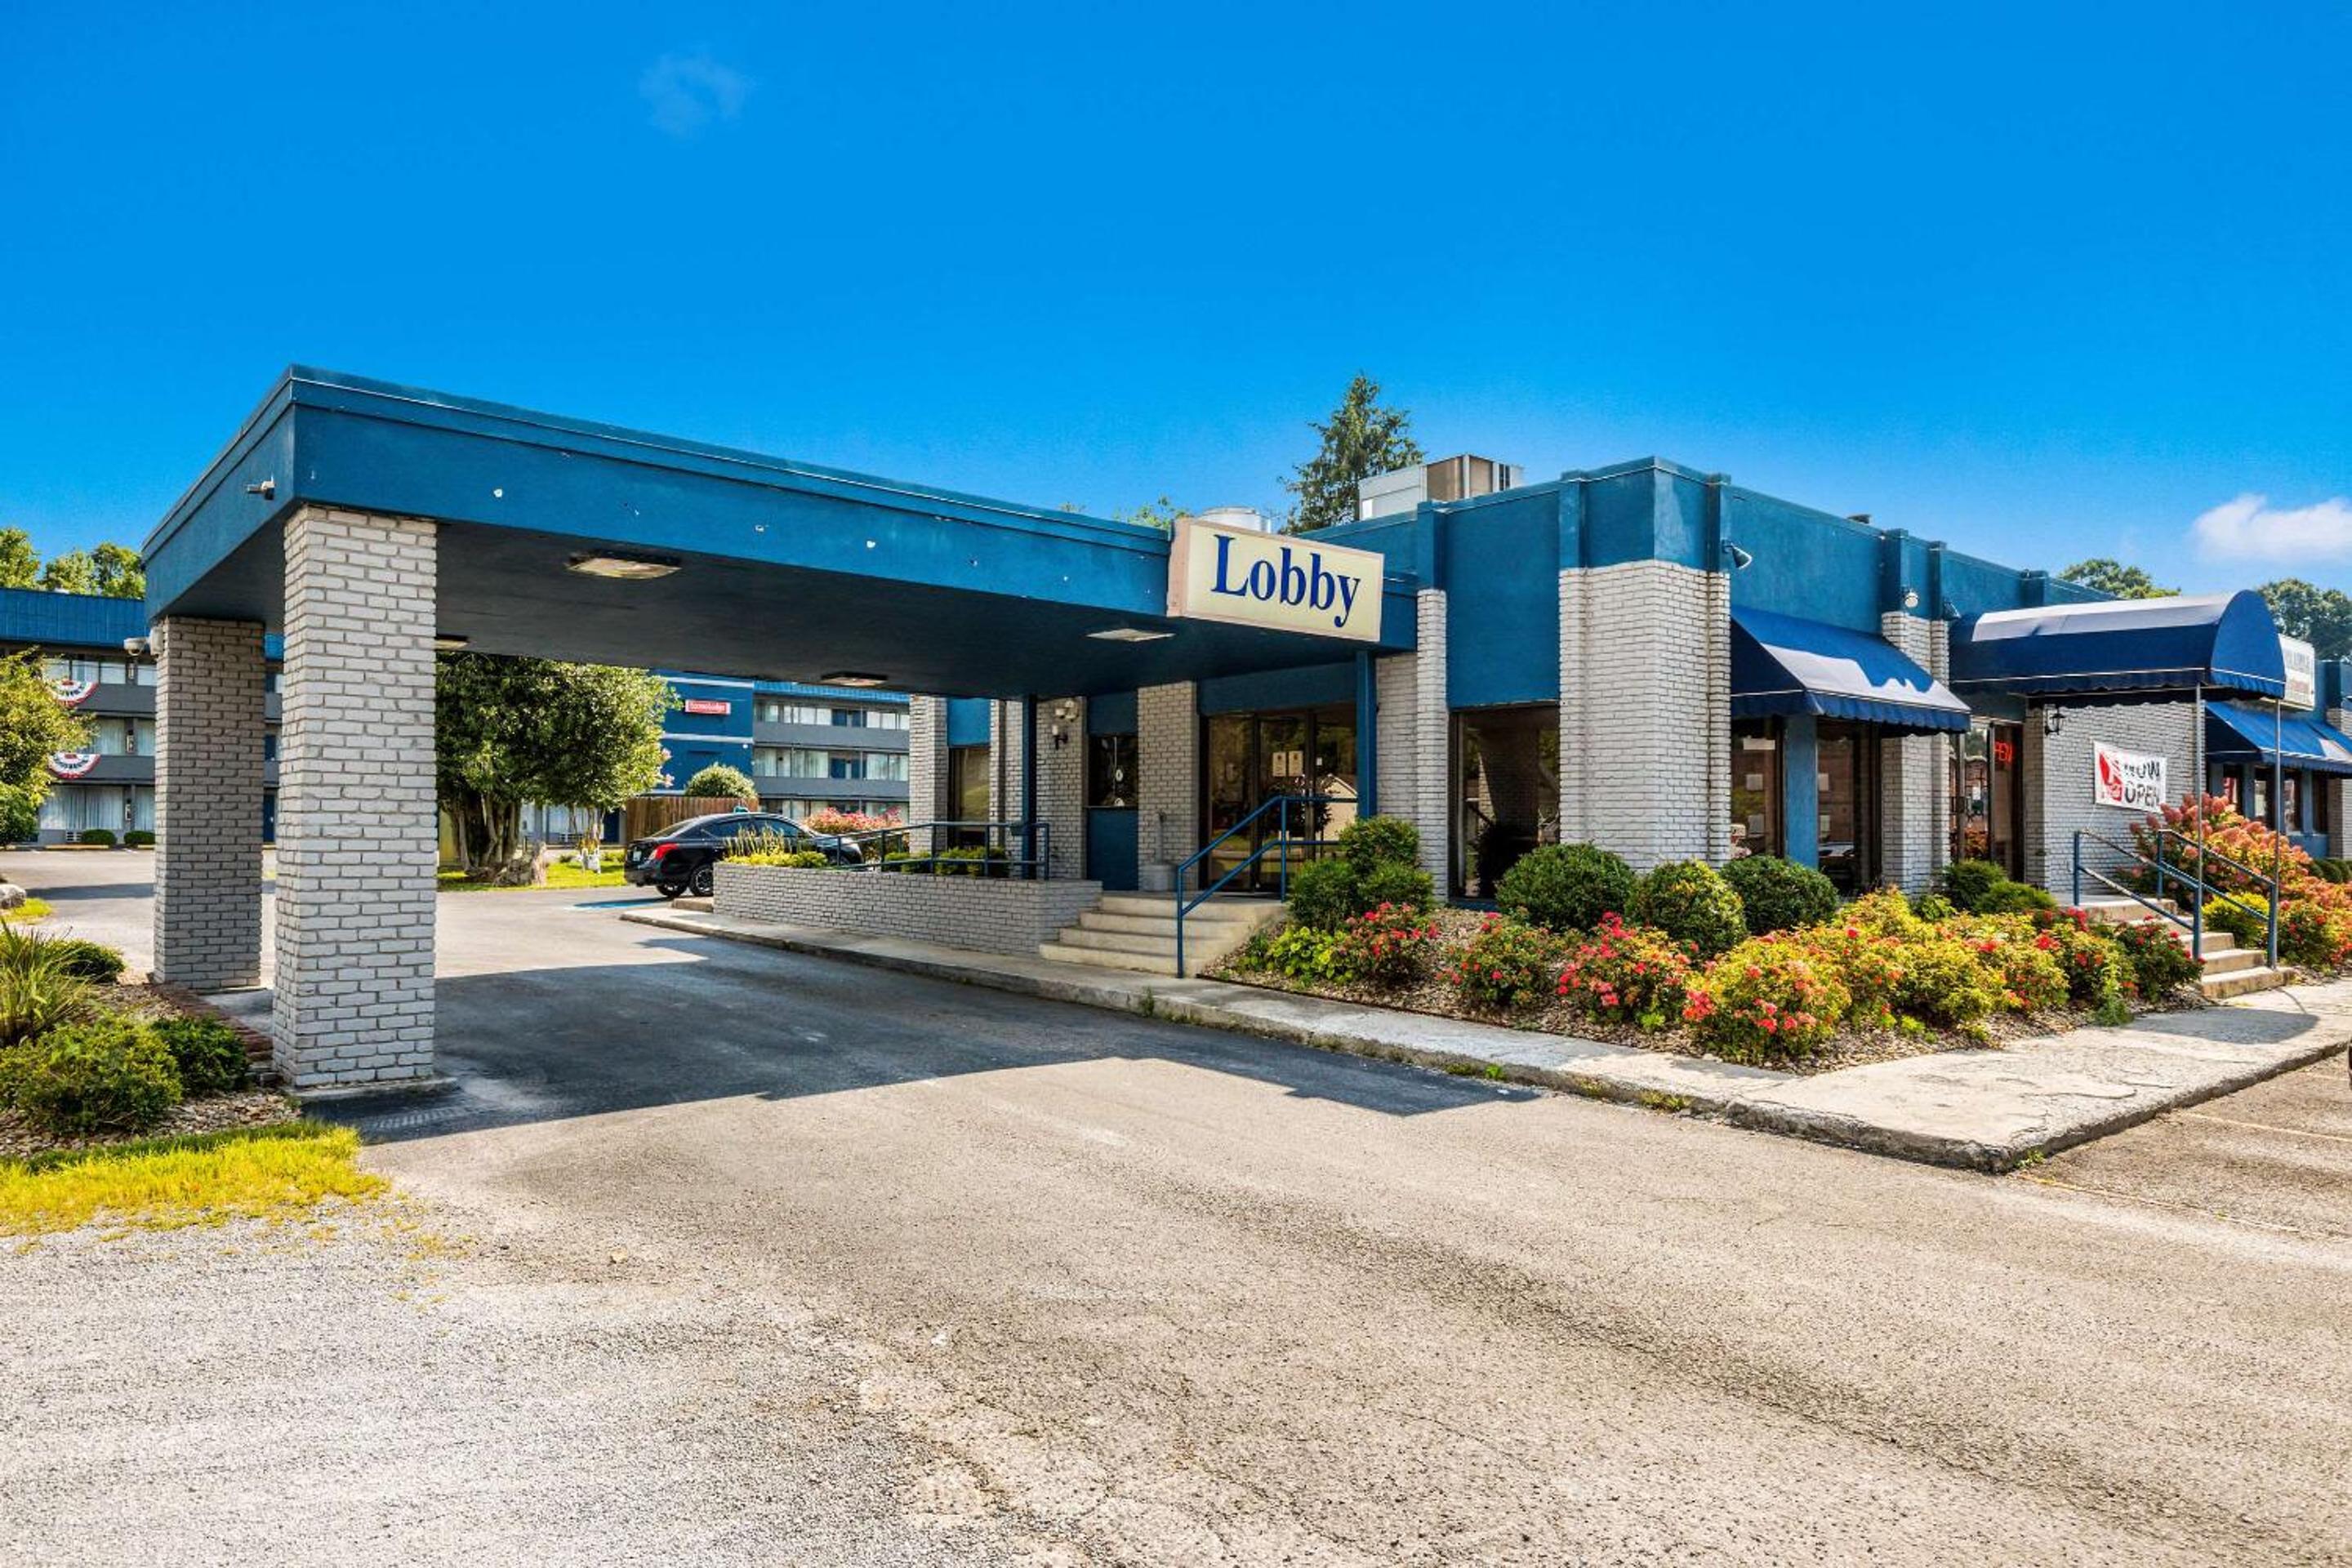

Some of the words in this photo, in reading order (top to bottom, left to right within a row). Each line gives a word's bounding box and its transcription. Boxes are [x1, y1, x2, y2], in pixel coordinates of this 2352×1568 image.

[1210, 534, 1361, 628] Lobby
[2124, 760, 2160, 780] NOW
[2124, 781, 2160, 808] OPEN
